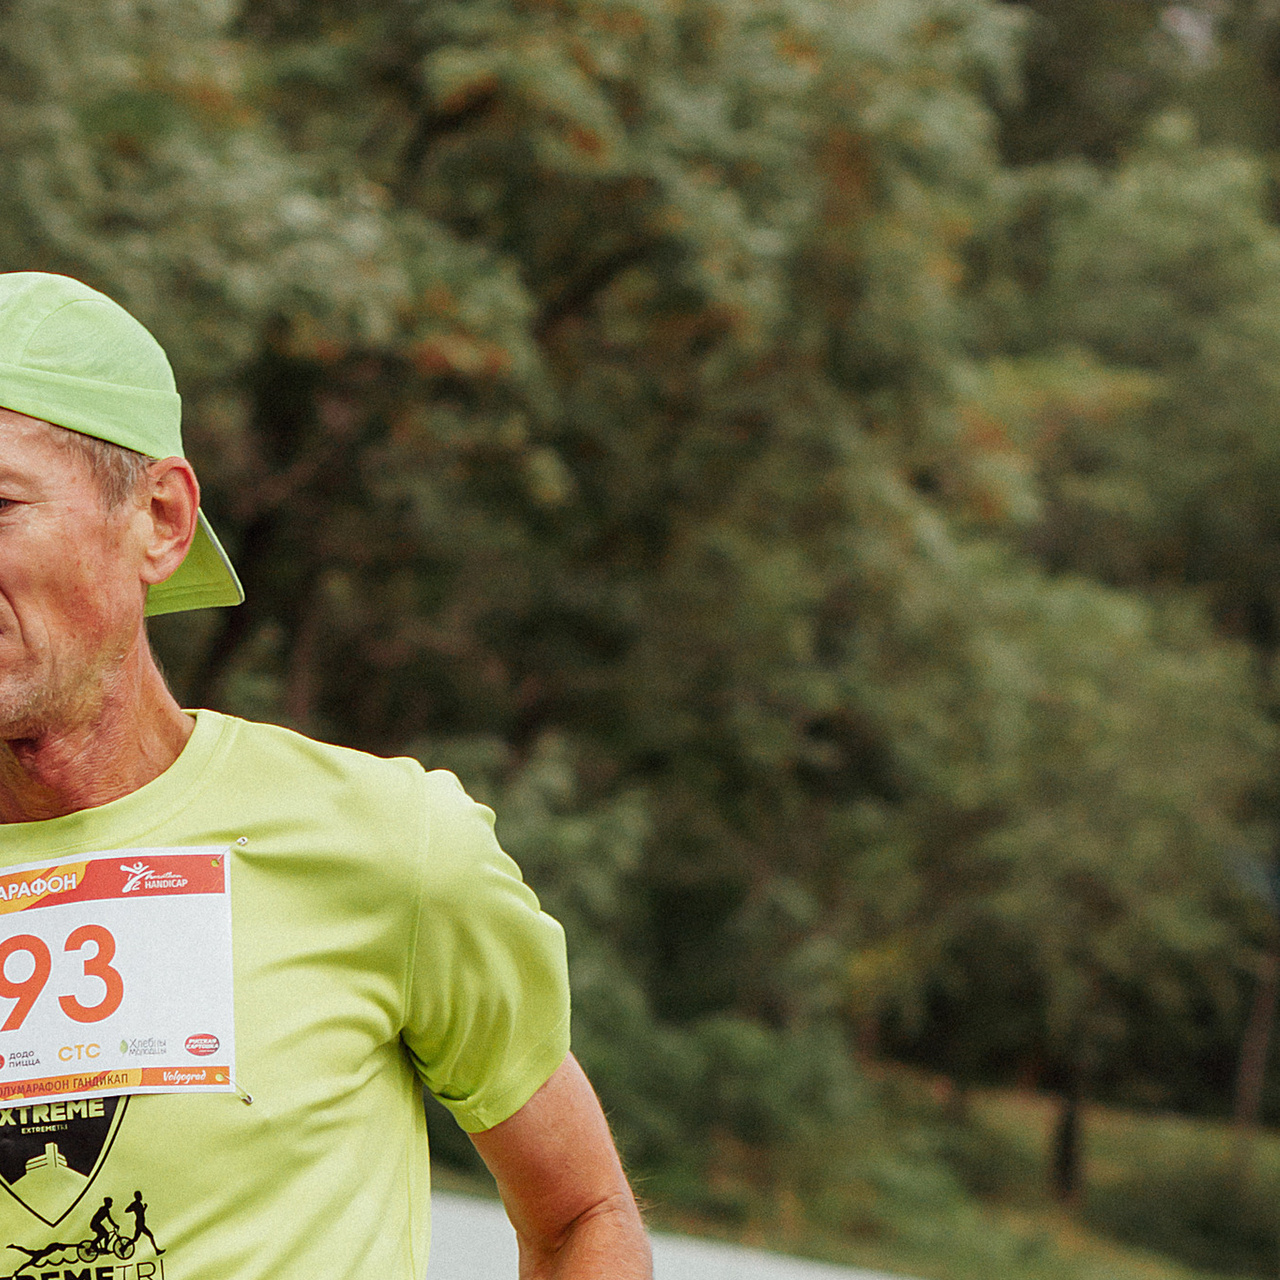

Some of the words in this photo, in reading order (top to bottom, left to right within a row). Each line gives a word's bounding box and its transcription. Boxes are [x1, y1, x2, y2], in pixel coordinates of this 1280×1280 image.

[144, 879, 189, 889] HANDICAP
[9, 1050, 35, 1060] ДОДО
[58, 1043, 100, 1062] СТС
[9, 1058, 41, 1068] ПИЦЦА
[73, 1073, 129, 1089] ГАНДИКАП
[163, 1070, 207, 1085] Volgograd
